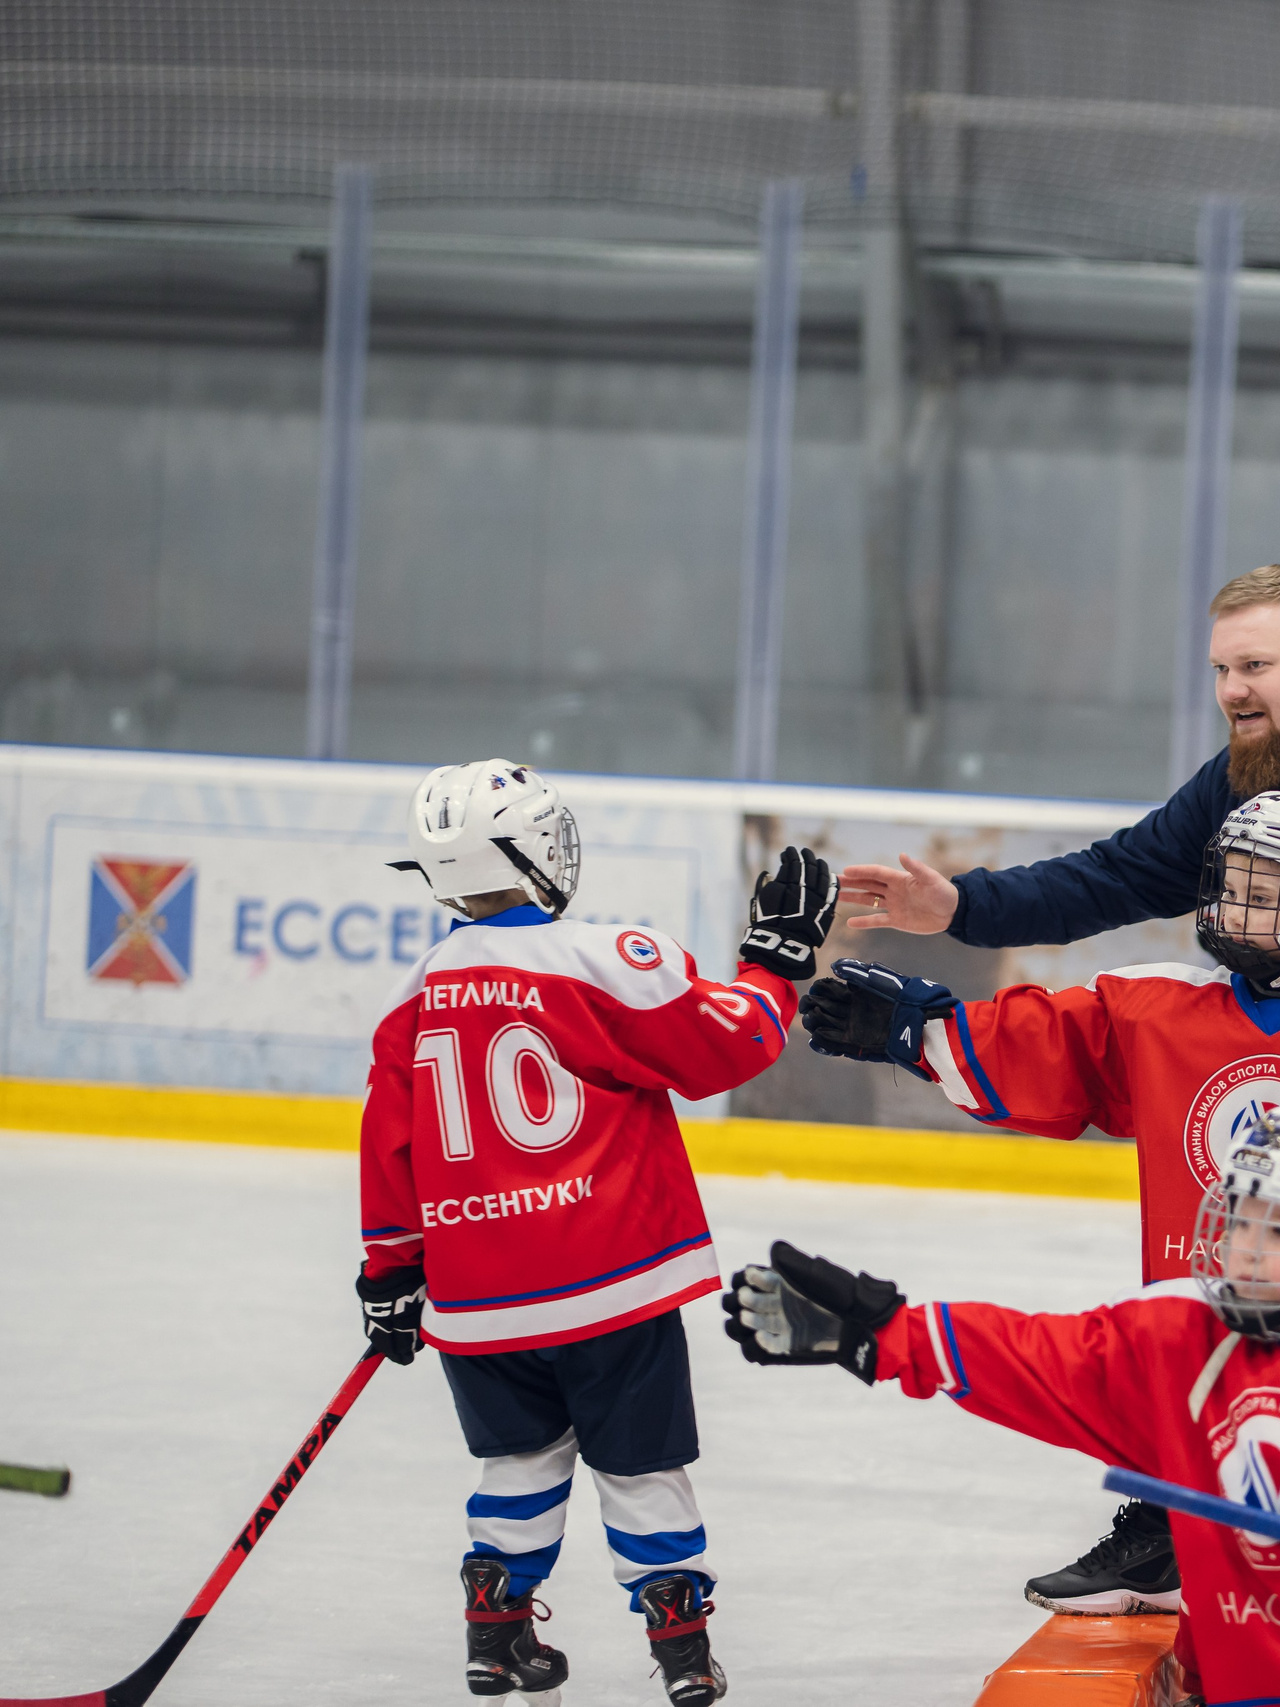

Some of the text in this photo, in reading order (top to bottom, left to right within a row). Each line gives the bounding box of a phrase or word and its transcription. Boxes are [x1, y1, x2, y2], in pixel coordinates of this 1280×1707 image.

[412, 1021, 585, 1162] 10
[1228, 1063, 1277, 1083] СПОРТА
[1197, 1080, 1227, 1119] ВИДОВ
[1191, 1121, 1209, 1172] ЗИМНИХ
[421, 1175, 593, 1228] ЕССЕНТУКИ
[232, 1412, 343, 1555] TAMPA
